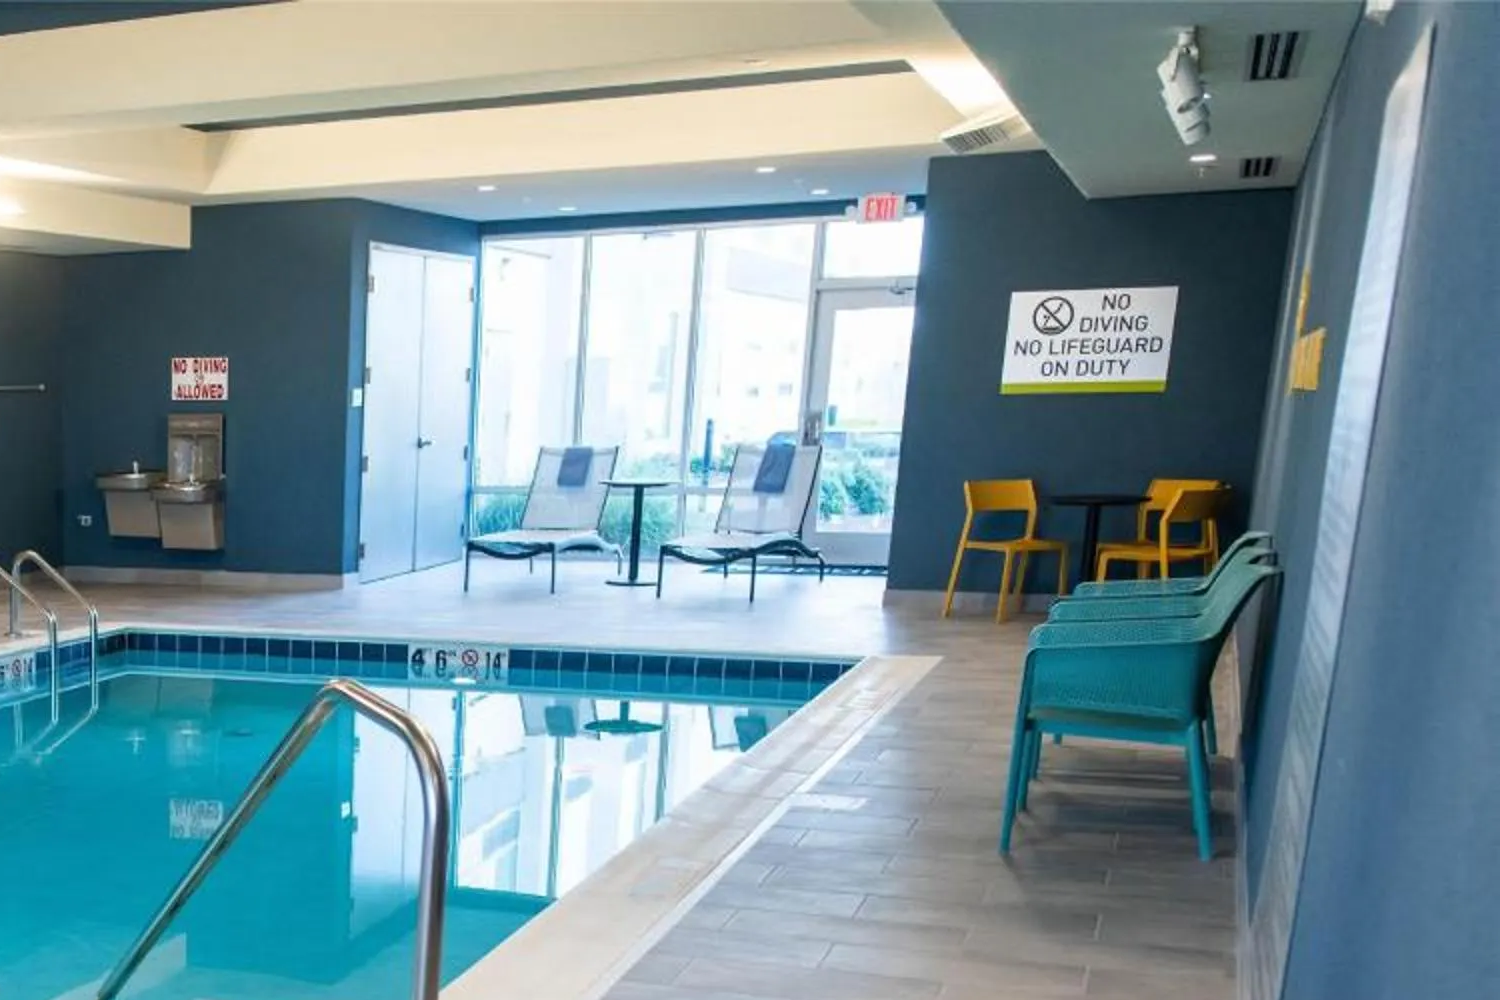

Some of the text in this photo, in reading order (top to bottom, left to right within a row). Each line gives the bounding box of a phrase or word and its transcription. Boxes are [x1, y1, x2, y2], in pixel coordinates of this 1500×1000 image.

[865, 196, 897, 221] EXIT
[1102, 293, 1131, 311] NO
[1079, 315, 1149, 333] DIVING
[1013, 336, 1163, 356] NO LIFEGUARD
[173, 359, 227, 374] NO DIVING
[1041, 358, 1131, 377] ON DUTY
[176, 384, 224, 399] ALLOWED
